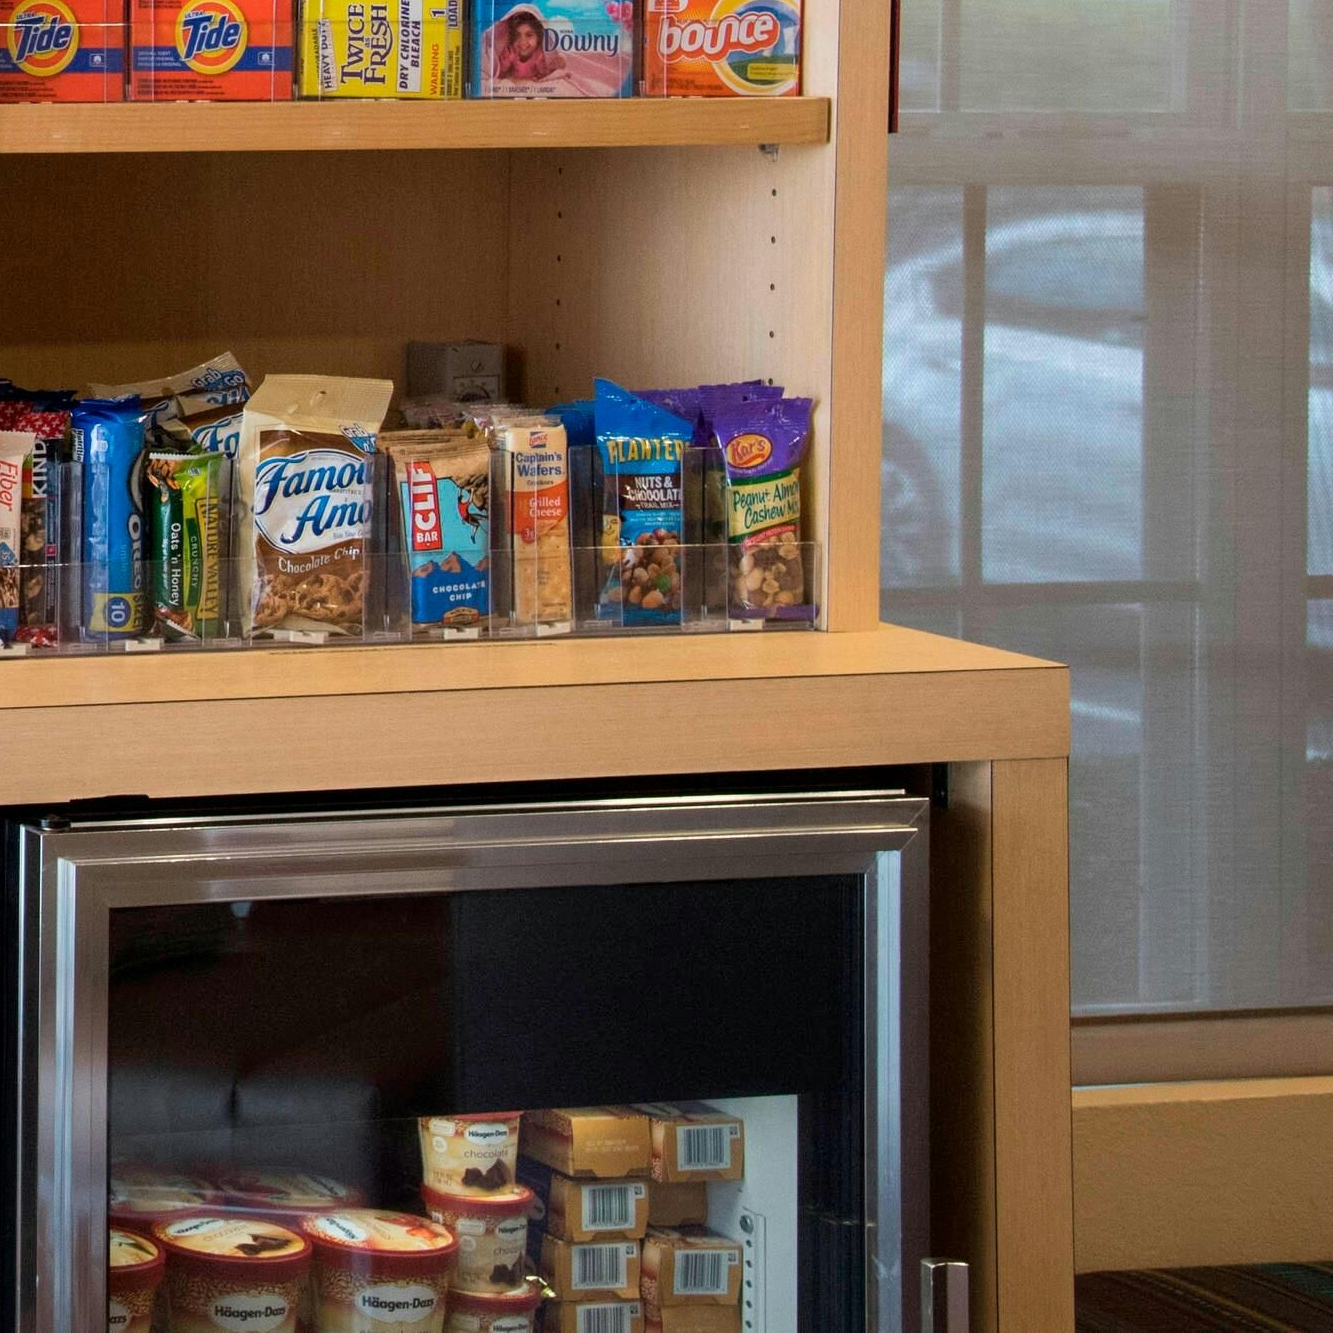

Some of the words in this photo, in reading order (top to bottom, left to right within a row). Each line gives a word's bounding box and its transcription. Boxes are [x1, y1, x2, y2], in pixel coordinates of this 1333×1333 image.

[12, 14, 74, 63] Tide
[340, 4, 365, 84] TWICE
[364, 4, 393, 85] FRESH
[400, 0, 410, 65] CHLORINE
[409, 21, 420, 68] BLEACH
[543, 27, 619, 57] Downy
[659, 15, 774, 55] bounce
[430, 43, 439, 96] WARNING
[515, 451, 563, 464] Captain's
[731, 436, 766, 460] Kar's
[31, 439, 48, 499] KIND
[634, 476, 661, 489] NUTS
[410, 467, 437, 531] CLIF
[529, 496, 561, 508] Grilled
[733, 488, 772, 513] Peanut
[744, 504, 785, 529] Cashew
[171, 522, 183, 551] Oats
[416, 531, 438, 543] BAR
[334, 547, 361, 561] Chip
[168, 568, 182, 607] Honey
[449, 592, 473, 602] CHIP
